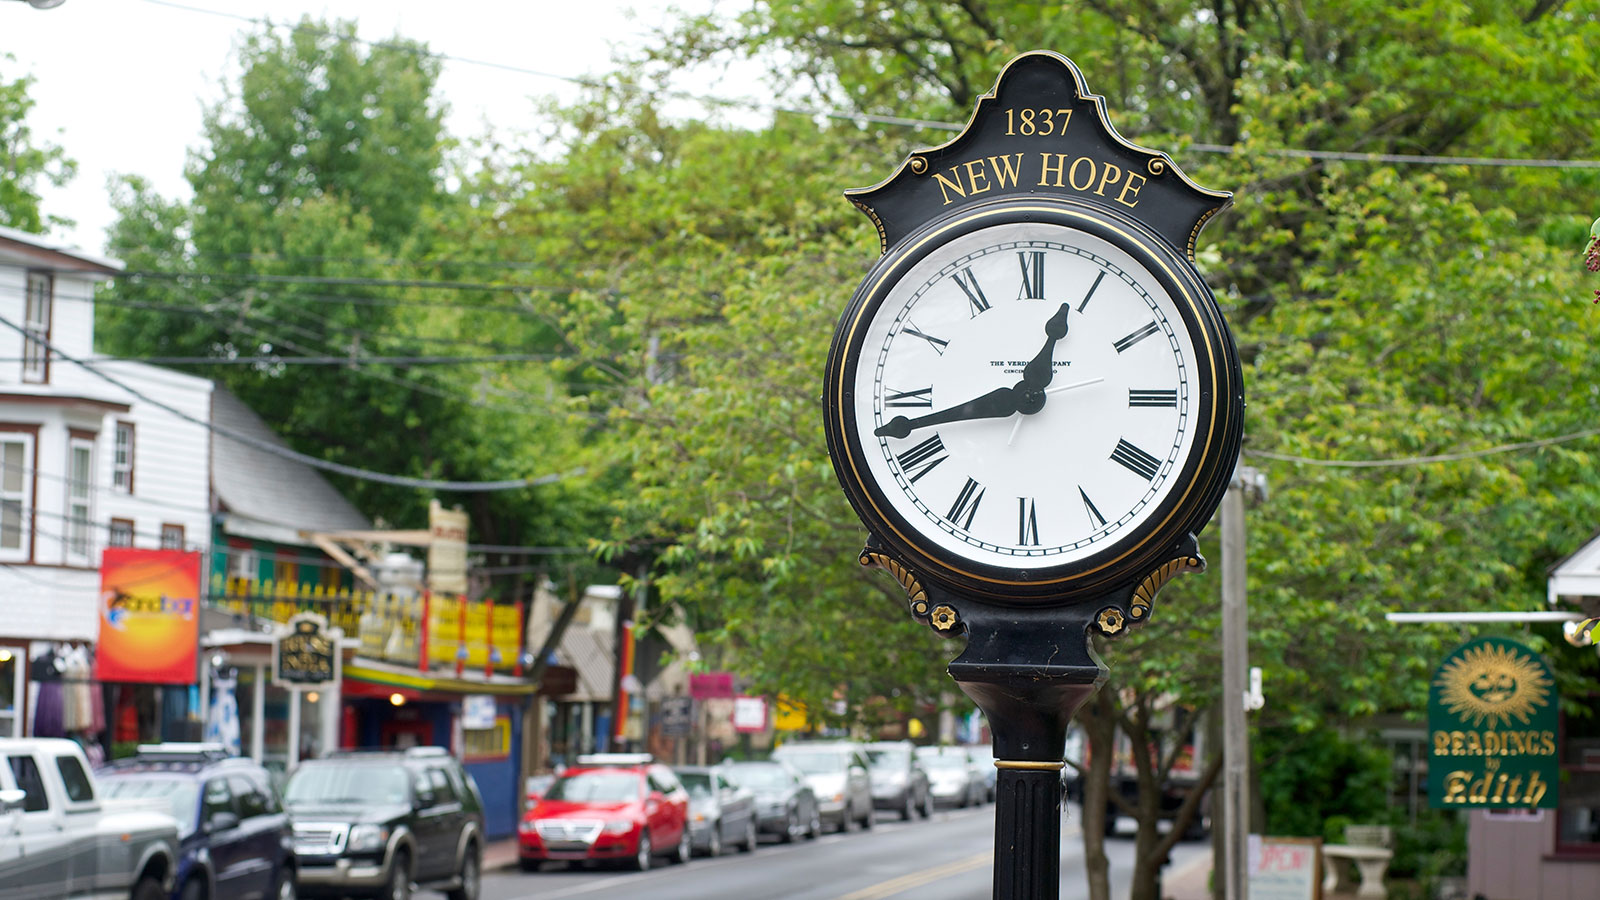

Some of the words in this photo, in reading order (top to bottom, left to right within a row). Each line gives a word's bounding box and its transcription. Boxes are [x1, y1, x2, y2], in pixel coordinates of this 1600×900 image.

[1005, 108, 1073, 136] 1837
[931, 152, 1025, 206] NEW
[1036, 152, 1147, 209] HOPE
[1016, 251, 1048, 300] XII
[1128, 387, 1178, 409] III
[1433, 730, 1555, 756] READINGS
[1442, 769, 1547, 808] Edith
